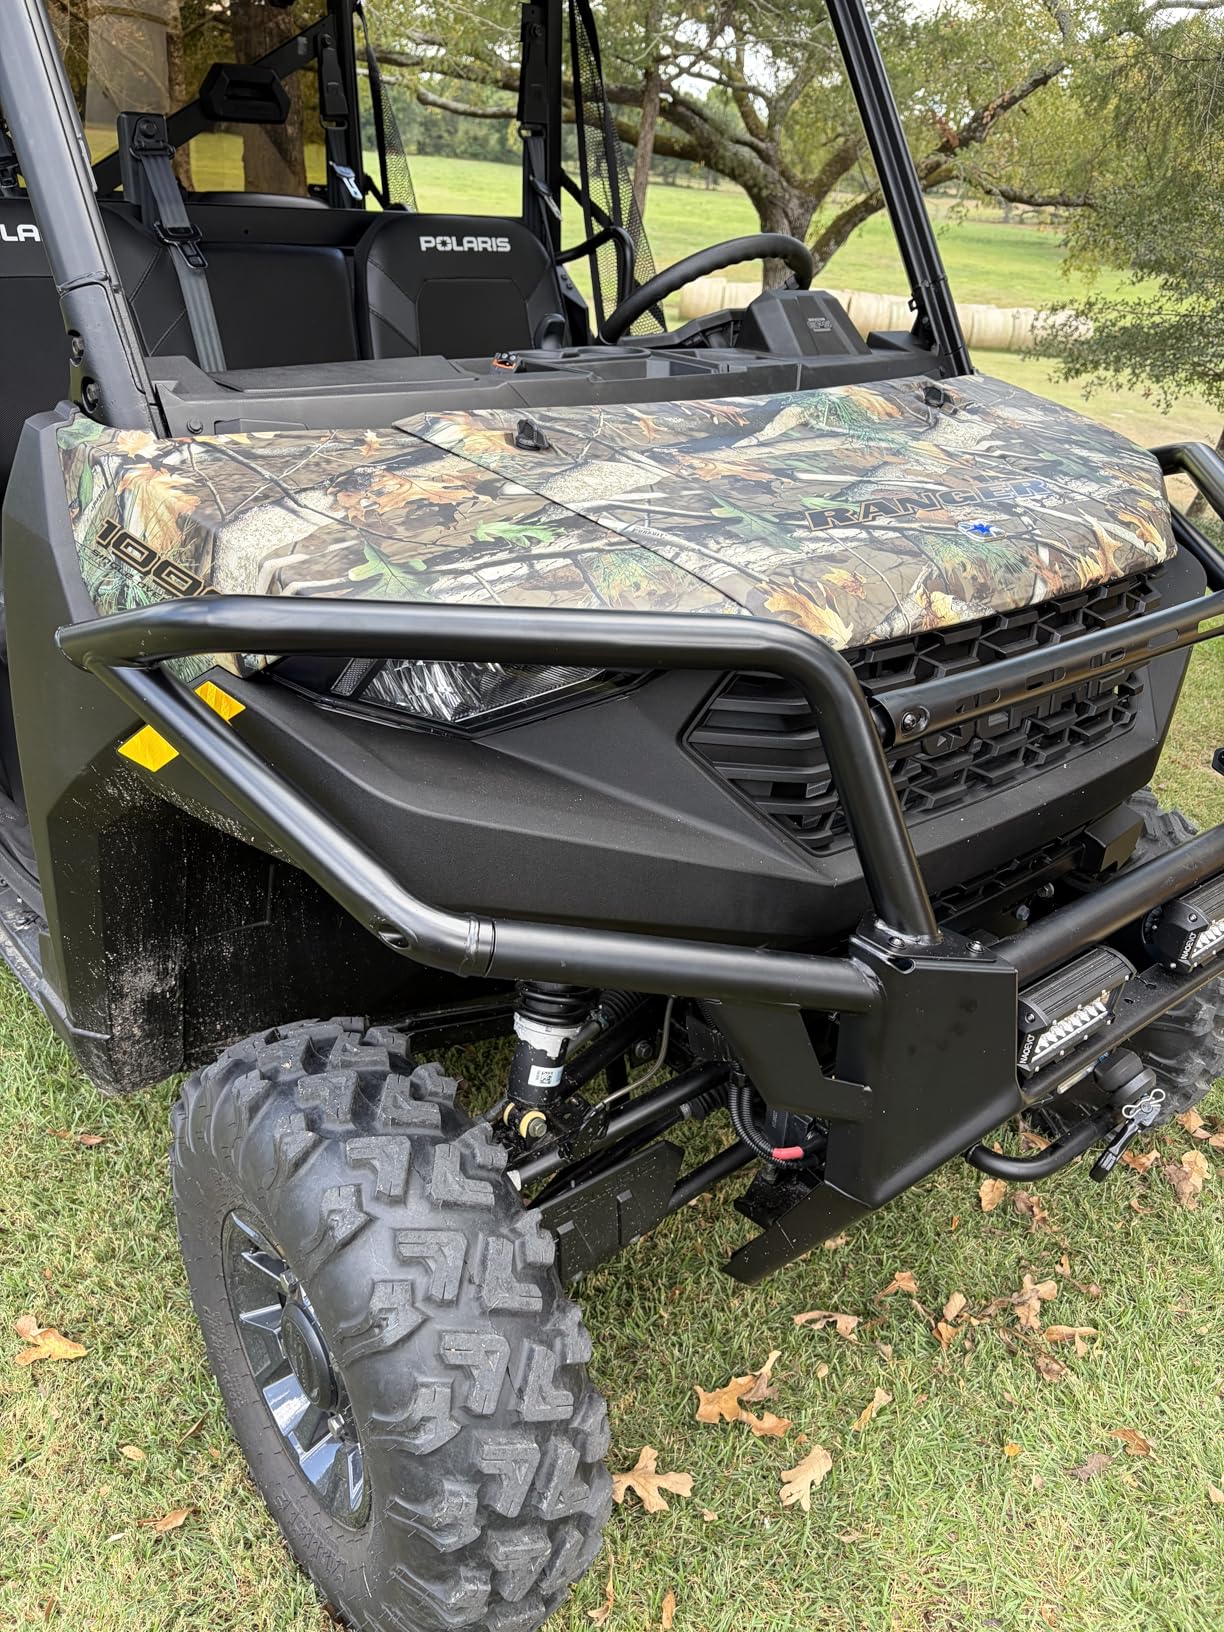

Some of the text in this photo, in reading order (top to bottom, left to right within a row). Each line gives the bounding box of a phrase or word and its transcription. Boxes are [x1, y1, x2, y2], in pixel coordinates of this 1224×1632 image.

[419, 236, 511, 252] POLARIS
[803, 478, 1051, 531] RANGER
[96, 516, 224, 598] 100
[1019, 1034, 1035, 1064] NAOEVO
